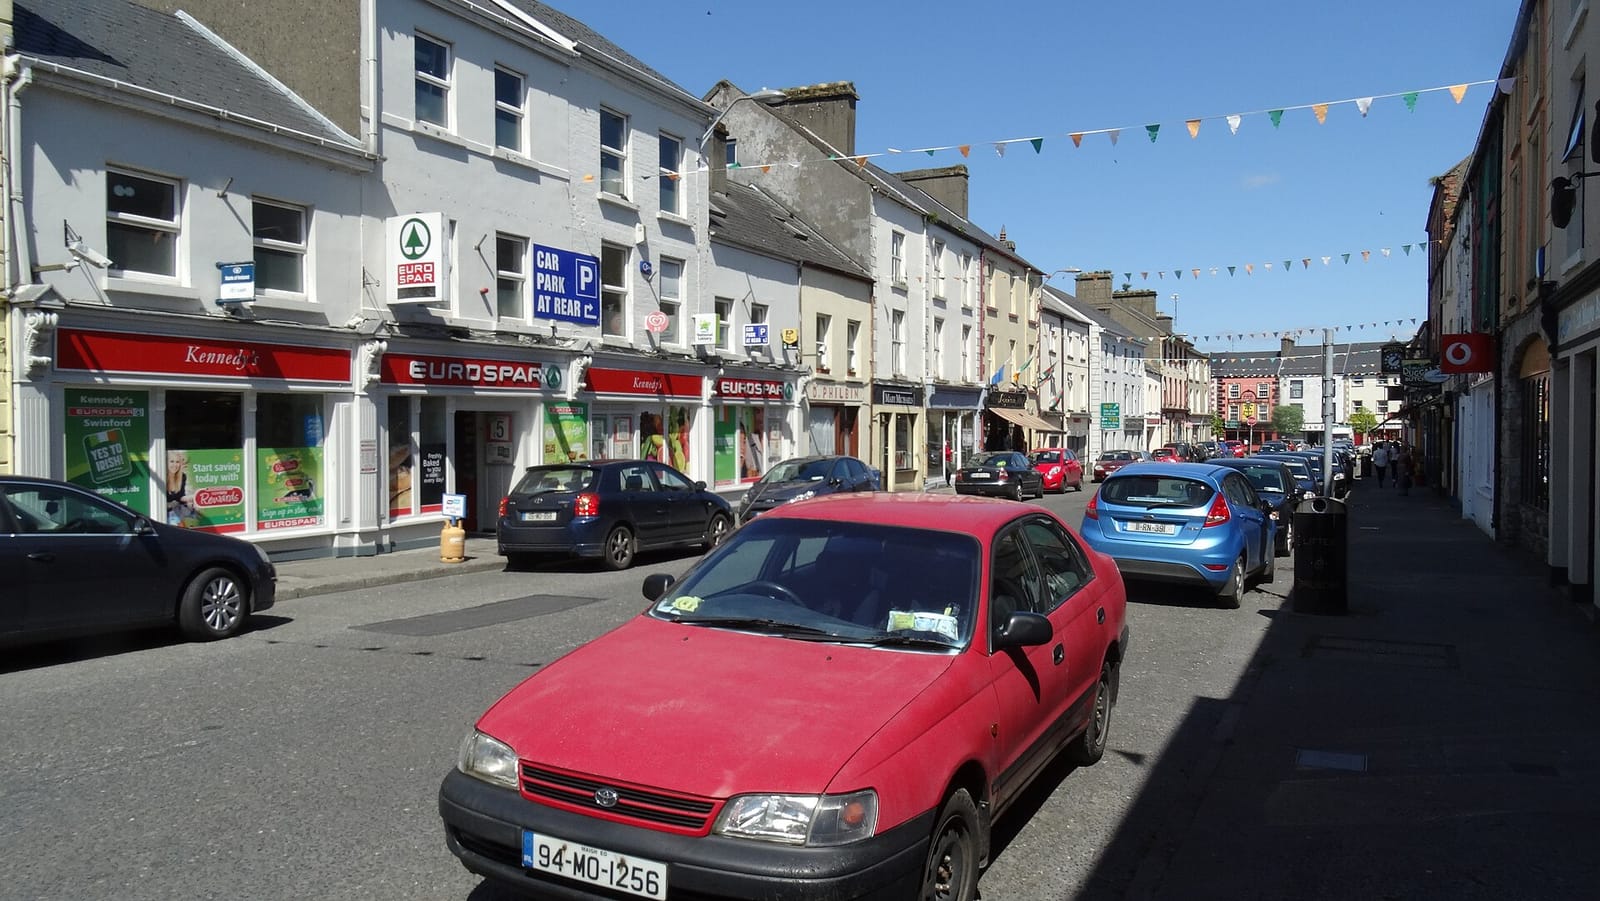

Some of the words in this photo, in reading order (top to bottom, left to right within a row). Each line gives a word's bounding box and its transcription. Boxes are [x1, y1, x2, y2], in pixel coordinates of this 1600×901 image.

[536, 250, 559, 271] CAR
[398, 263, 433, 274] EURO
[399, 273, 433, 284] SPAR
[536, 275, 565, 294] PARK
[580, 265, 593, 291] P
[537, 294, 550, 313] AT
[554, 297, 581, 317] REAR
[185, 345, 260, 370] Kennedy's
[409, 360, 547, 383] EUROSPAR
[632, 377, 663, 393] Kennedy's
[720, 381, 784, 395] EUROSPAR
[822, 386, 860, 400] PHILBIN
[80, 395, 134, 406] Kennedy's
[76, 408, 133, 416] EUROSPAR
[83, 419, 131, 427] Swinford
[496, 420, 504, 439] 5
[90, 446, 109, 461] YES
[110, 443, 123, 455] TO
[95, 455, 125, 473] IRISH!
[193, 463, 213, 472] Start
[214, 463, 241, 474] saving
[422, 459, 440, 467] Baked
[195, 474, 219, 484] today
[220, 473, 239, 482] with
[200, 492, 240, 506] Rewards
[262, 508, 276, 519] Sign
[264, 517, 317, 529] EUROSPAR
[538, 843, 660, 896] 94-MO-1256
